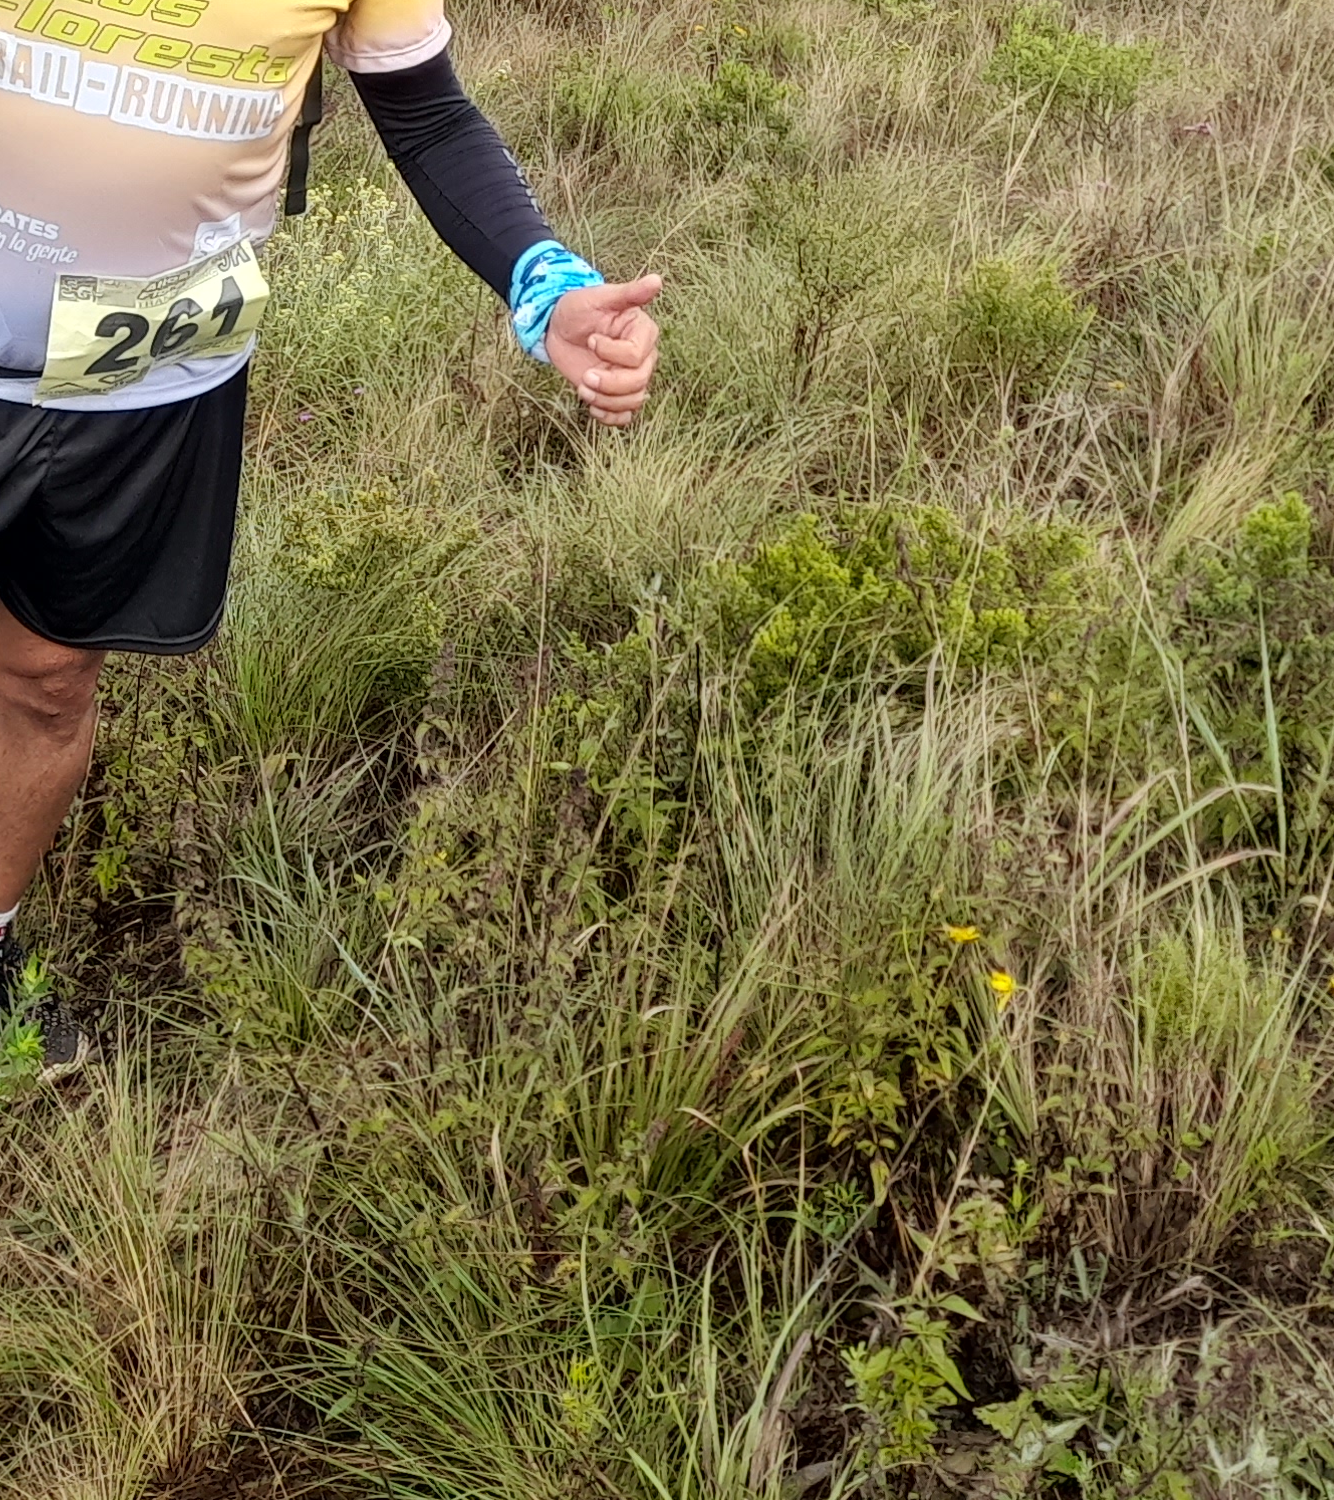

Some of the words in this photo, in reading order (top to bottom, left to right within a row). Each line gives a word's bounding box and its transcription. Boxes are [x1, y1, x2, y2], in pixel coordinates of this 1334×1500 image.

[8, 232, 27, 253] la
[26, 243, 78, 264] gente
[84, 276, 244, 377] 261
